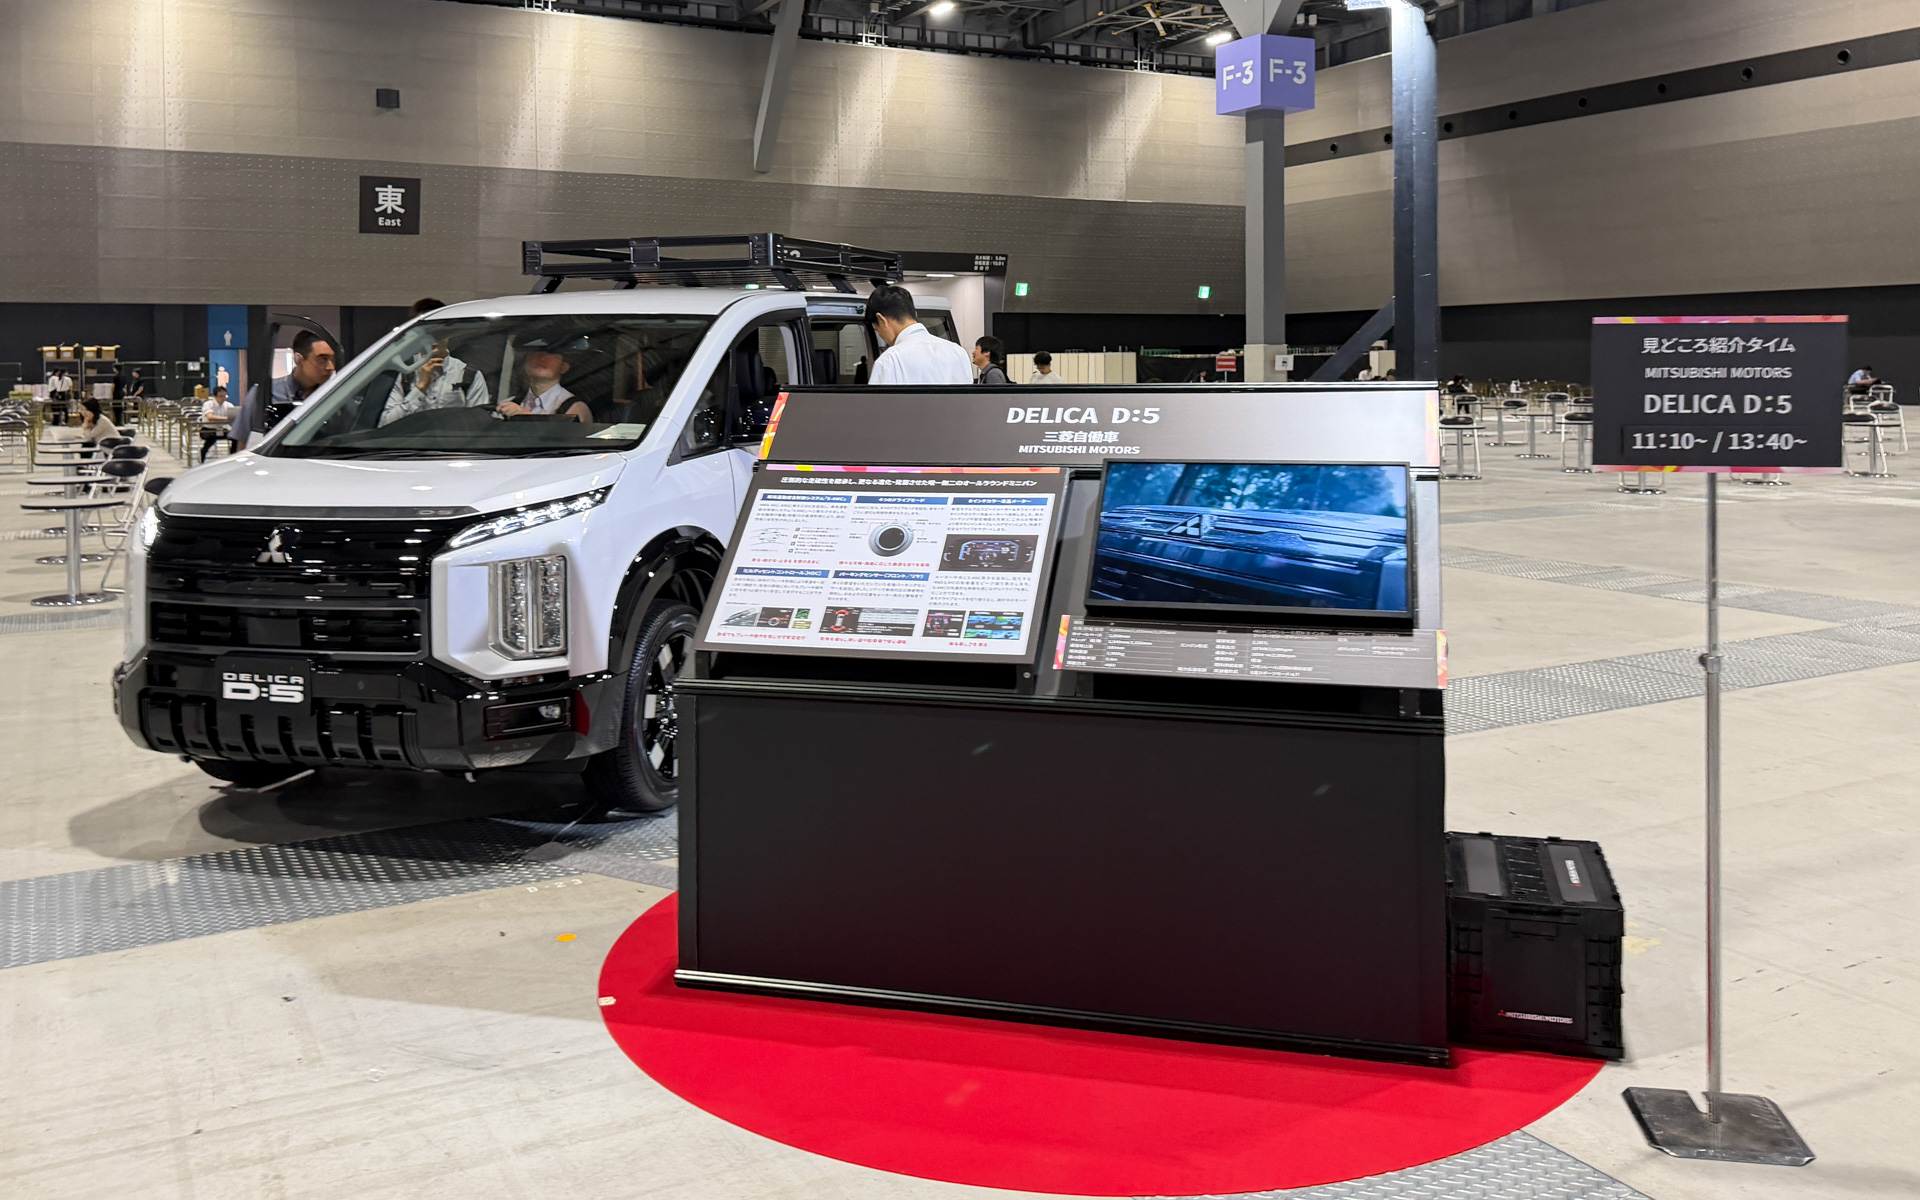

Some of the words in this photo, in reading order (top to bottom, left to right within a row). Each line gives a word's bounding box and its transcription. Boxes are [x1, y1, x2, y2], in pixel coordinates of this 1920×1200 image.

[1223, 60, 1253, 90] F-3
[1269, 58, 1306, 85] F-3
[374, 184, 406, 214] 東
[378, 217, 402, 227] East
[1641, 336, 1797, 354] 見どころ紹介タイム
[1644, 367, 1728, 379] MITSUBISHI
[1730, 367, 1793, 379] MOTORS
[1643, 394, 1736, 414] DELICA
[1743, 394, 1793, 414] D:5
[1006, 407, 1099, 424] DELICA
[1111, 407, 1161, 424] D:5
[1042, 430, 1120, 443] 三菱自動車
[1018, 445, 1086, 454] MITSUBISHI
[1088, 445, 1141, 455] MOTORS
[222, 672, 304, 684] DELICA
[222, 681, 304, 703] D:5
